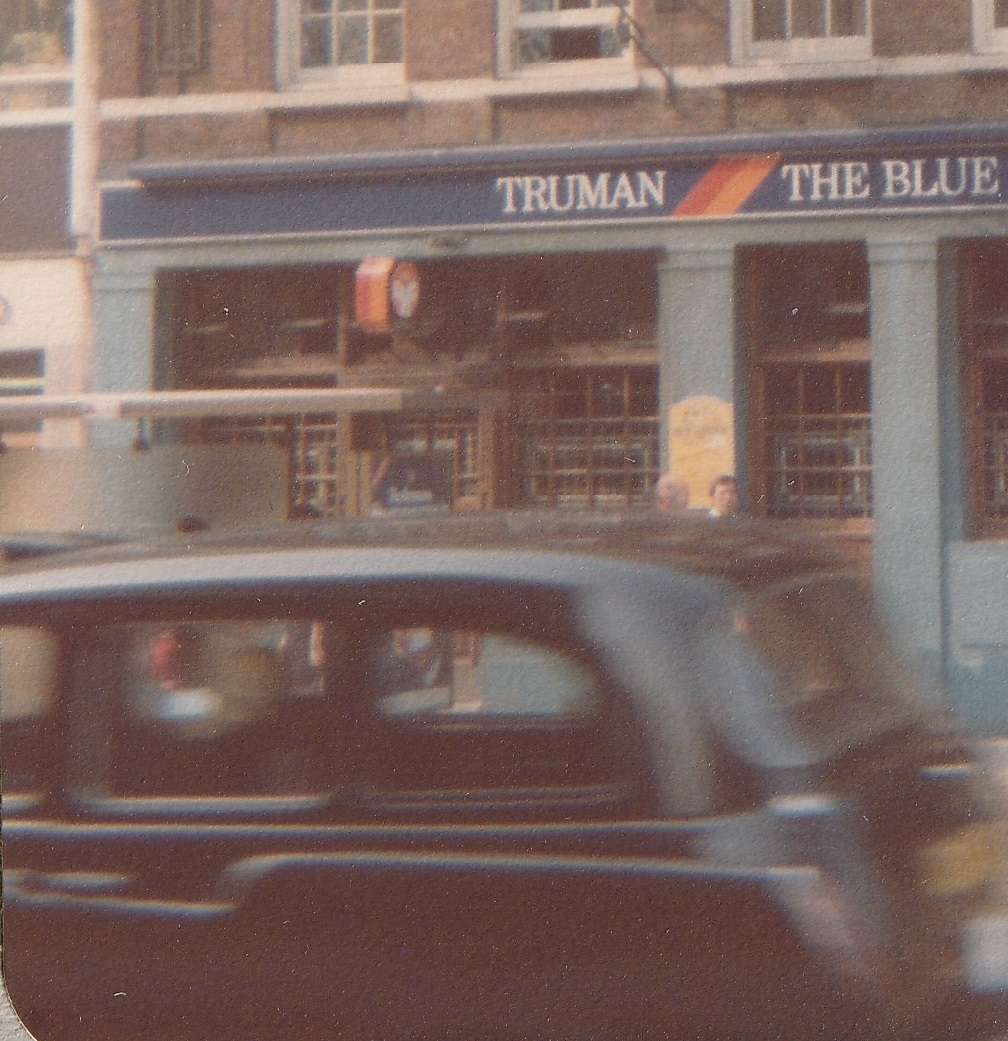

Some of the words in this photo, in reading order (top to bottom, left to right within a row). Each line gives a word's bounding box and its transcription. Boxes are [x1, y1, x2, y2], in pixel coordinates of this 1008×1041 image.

[496, 171, 667, 212] TRUMAN
[782, 162, 870, 200] THE
[882, 157, 998, 198] BLUE
